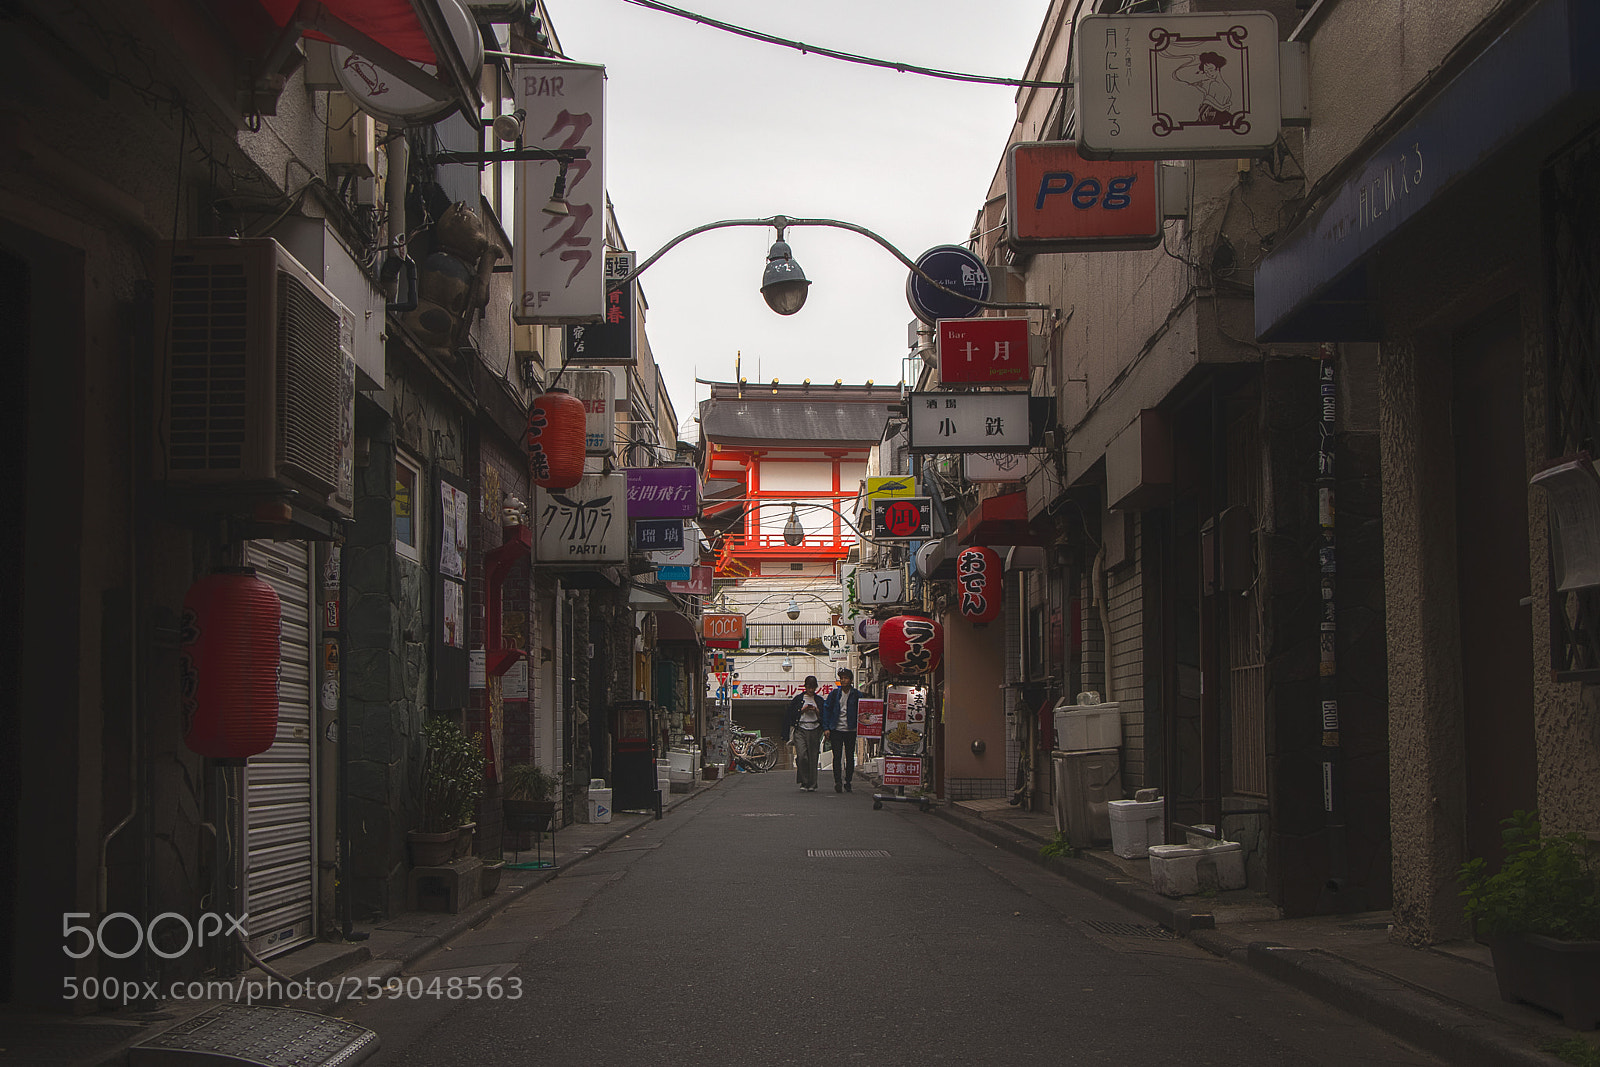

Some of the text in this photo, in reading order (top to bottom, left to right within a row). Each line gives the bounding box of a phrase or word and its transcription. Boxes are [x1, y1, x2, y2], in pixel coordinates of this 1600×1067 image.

[524, 76, 565, 97] BAR
[1104, 27, 1122, 138] 月に吠える
[540, 108, 593, 288] クラクラ
[1035, 171, 1138, 211] Peg
[522, 290, 551, 309] 2F
[948, 331, 966, 339] Bar
[959, 340, 1011, 362] 十月
[926, 399, 957, 409] 酒場
[938, 416, 1005, 437] 小鉄
[627, 485, 692, 502] 夜間飛行
[891, 504, 918, 531] 凪
[919, 504, 930, 532] 新宿
[569, 545, 606, 555] PART II
[959, 551, 987, 616] おでん
[886, 762, 920, 774] 営業中!
